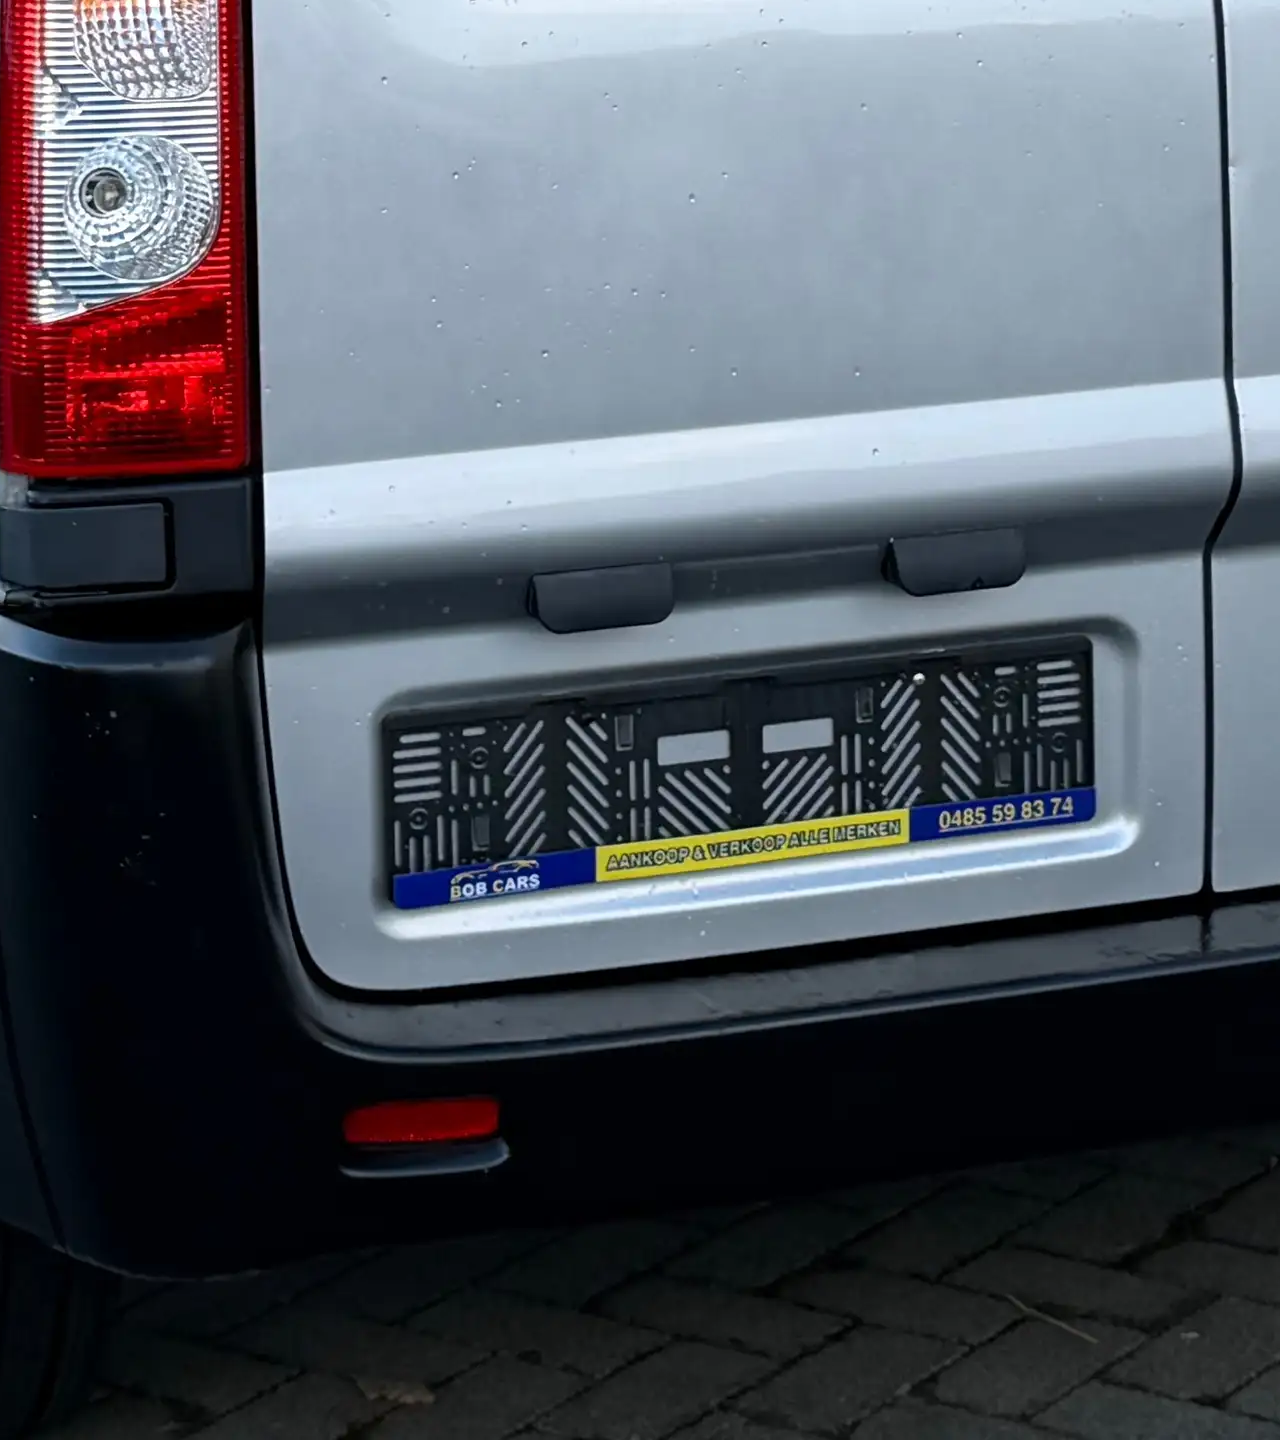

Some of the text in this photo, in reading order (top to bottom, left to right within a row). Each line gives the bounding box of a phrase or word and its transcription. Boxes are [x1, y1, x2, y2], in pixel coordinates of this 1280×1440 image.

[939, 796, 1073, 829] 0485 59 83 74
[606, 819, 901, 872] AANKOOP & VERKOOP ALLE MERKEN
[450, 873, 540, 901] BOB CARS
